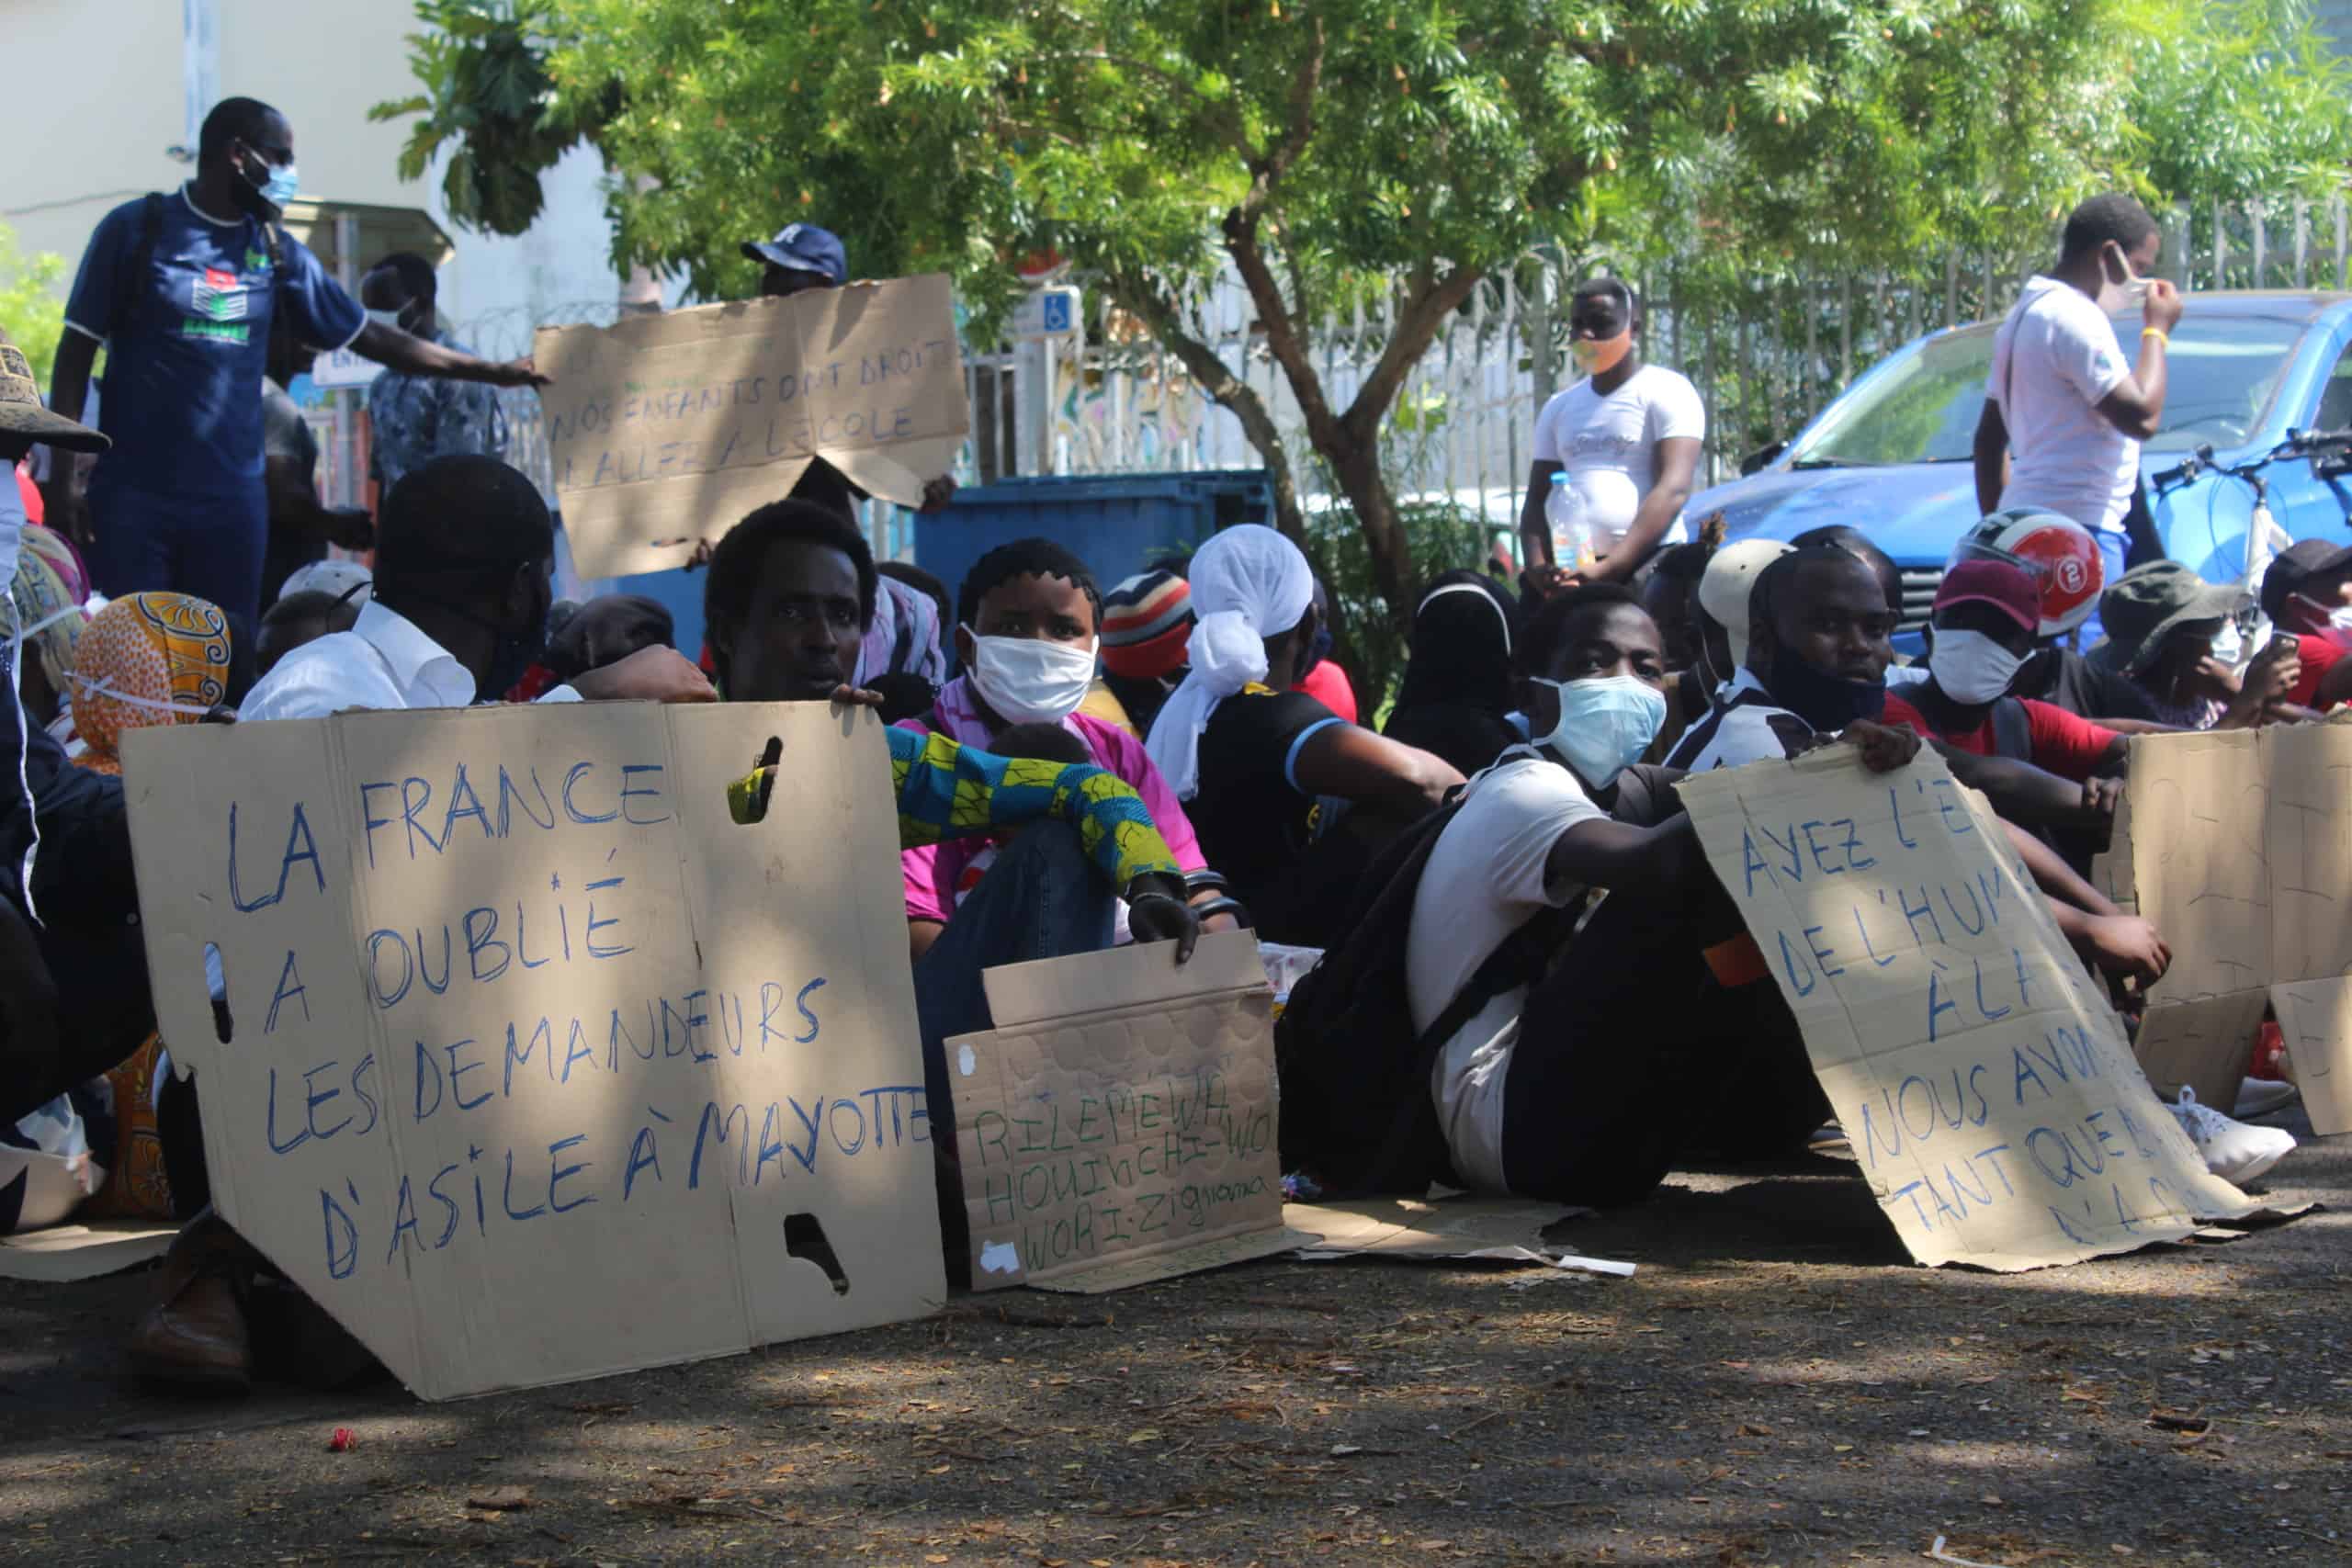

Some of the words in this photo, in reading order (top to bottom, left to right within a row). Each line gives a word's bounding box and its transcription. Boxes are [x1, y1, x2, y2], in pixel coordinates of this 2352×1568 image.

[228, 802, 326, 912] LA
[360, 762, 672, 870] FRANCE
[264, 950, 310, 1036] A
[1778, 926, 1845, 998] DE
[267, 1054, 379, 1156] LES
[414, 977, 830, 1126] DEMANDEURS
[1861, 1063, 1988, 1168] NOUS
[624, 1107, 673, 1202] À
[688, 1086, 934, 1191] MAYOTTE
[1888, 1145, 2017, 1234] TANT
